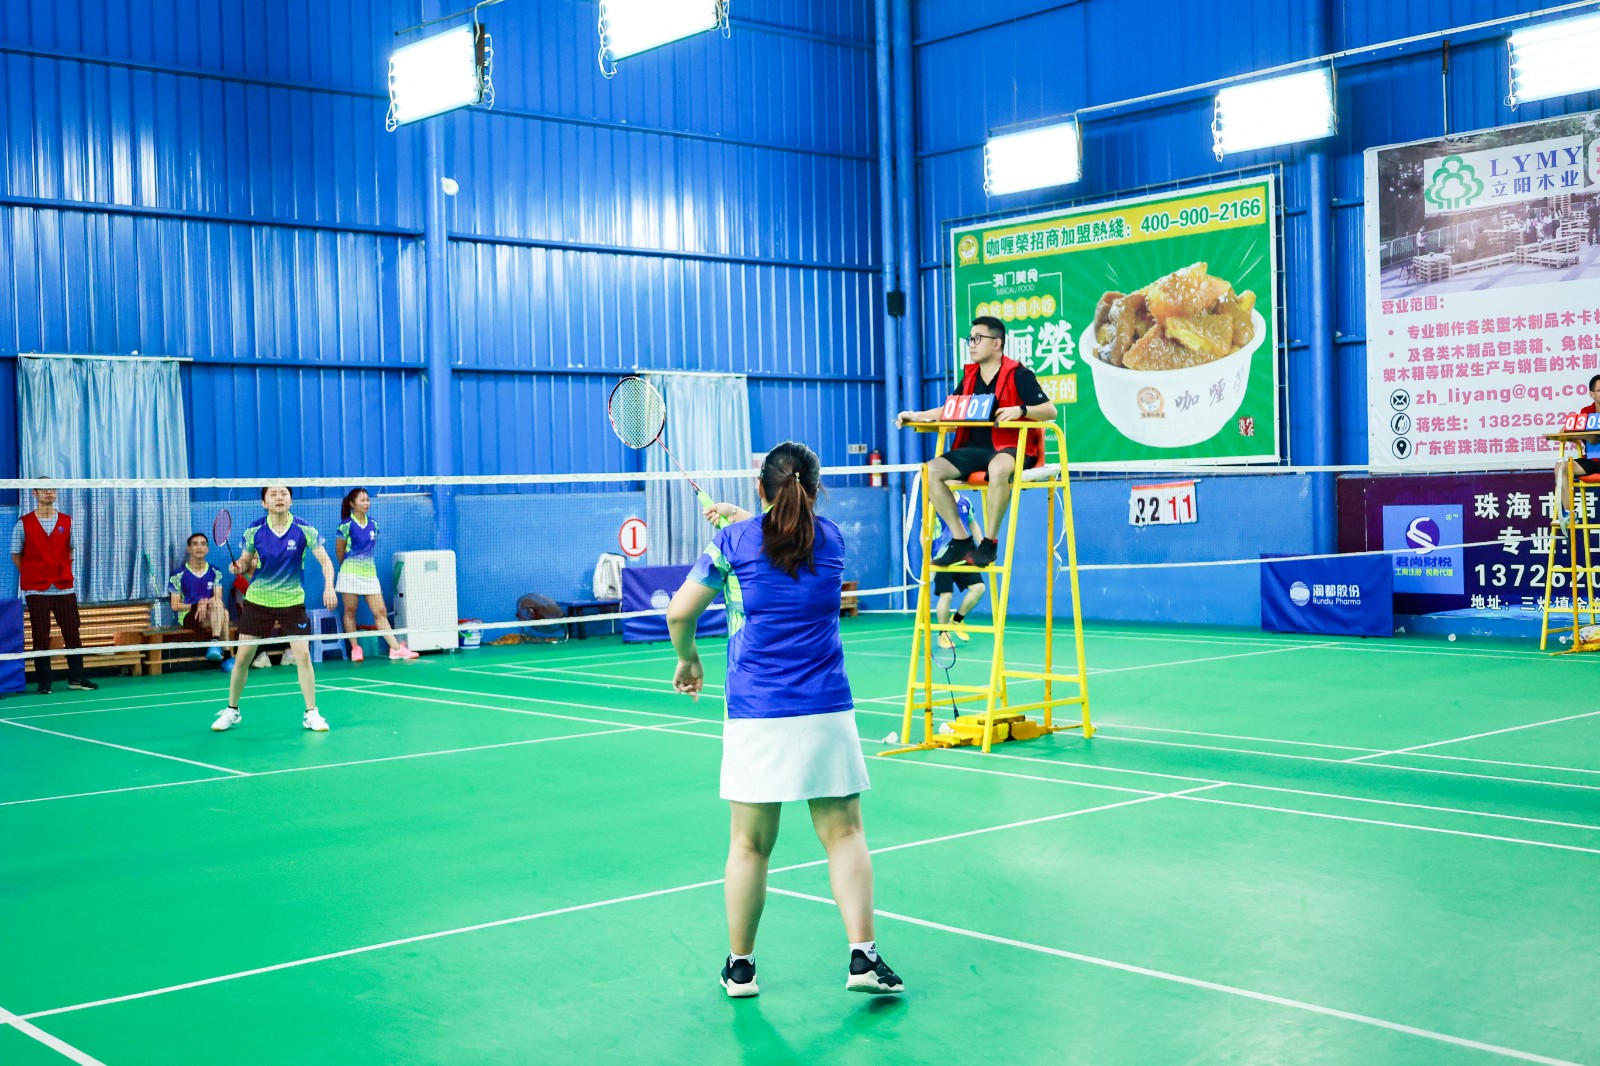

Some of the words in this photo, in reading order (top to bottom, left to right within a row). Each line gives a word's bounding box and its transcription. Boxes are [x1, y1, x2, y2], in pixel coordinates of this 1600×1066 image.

[1490, 146, 1583, 177] LYMY
[1491, 170, 1579, 198] 立阳木业
[1140, 198, 1261, 232] 400-900-2166
[1018, 284, 1035, 293] FOOD
[959, 320, 1076, 374] 喱榮
[1383, 353, 1600, 382] 架木箱等研发生产与销售的木制
[1479, 411, 1577, 428] 13825622
[1415, 436, 1577, 455] 广东省珠海市金湾区三
[629, 526, 638, 550] 1
[1396, 556, 1453, 567] 君尚财税
[1312, 585, 1360, 598] 润都股份
